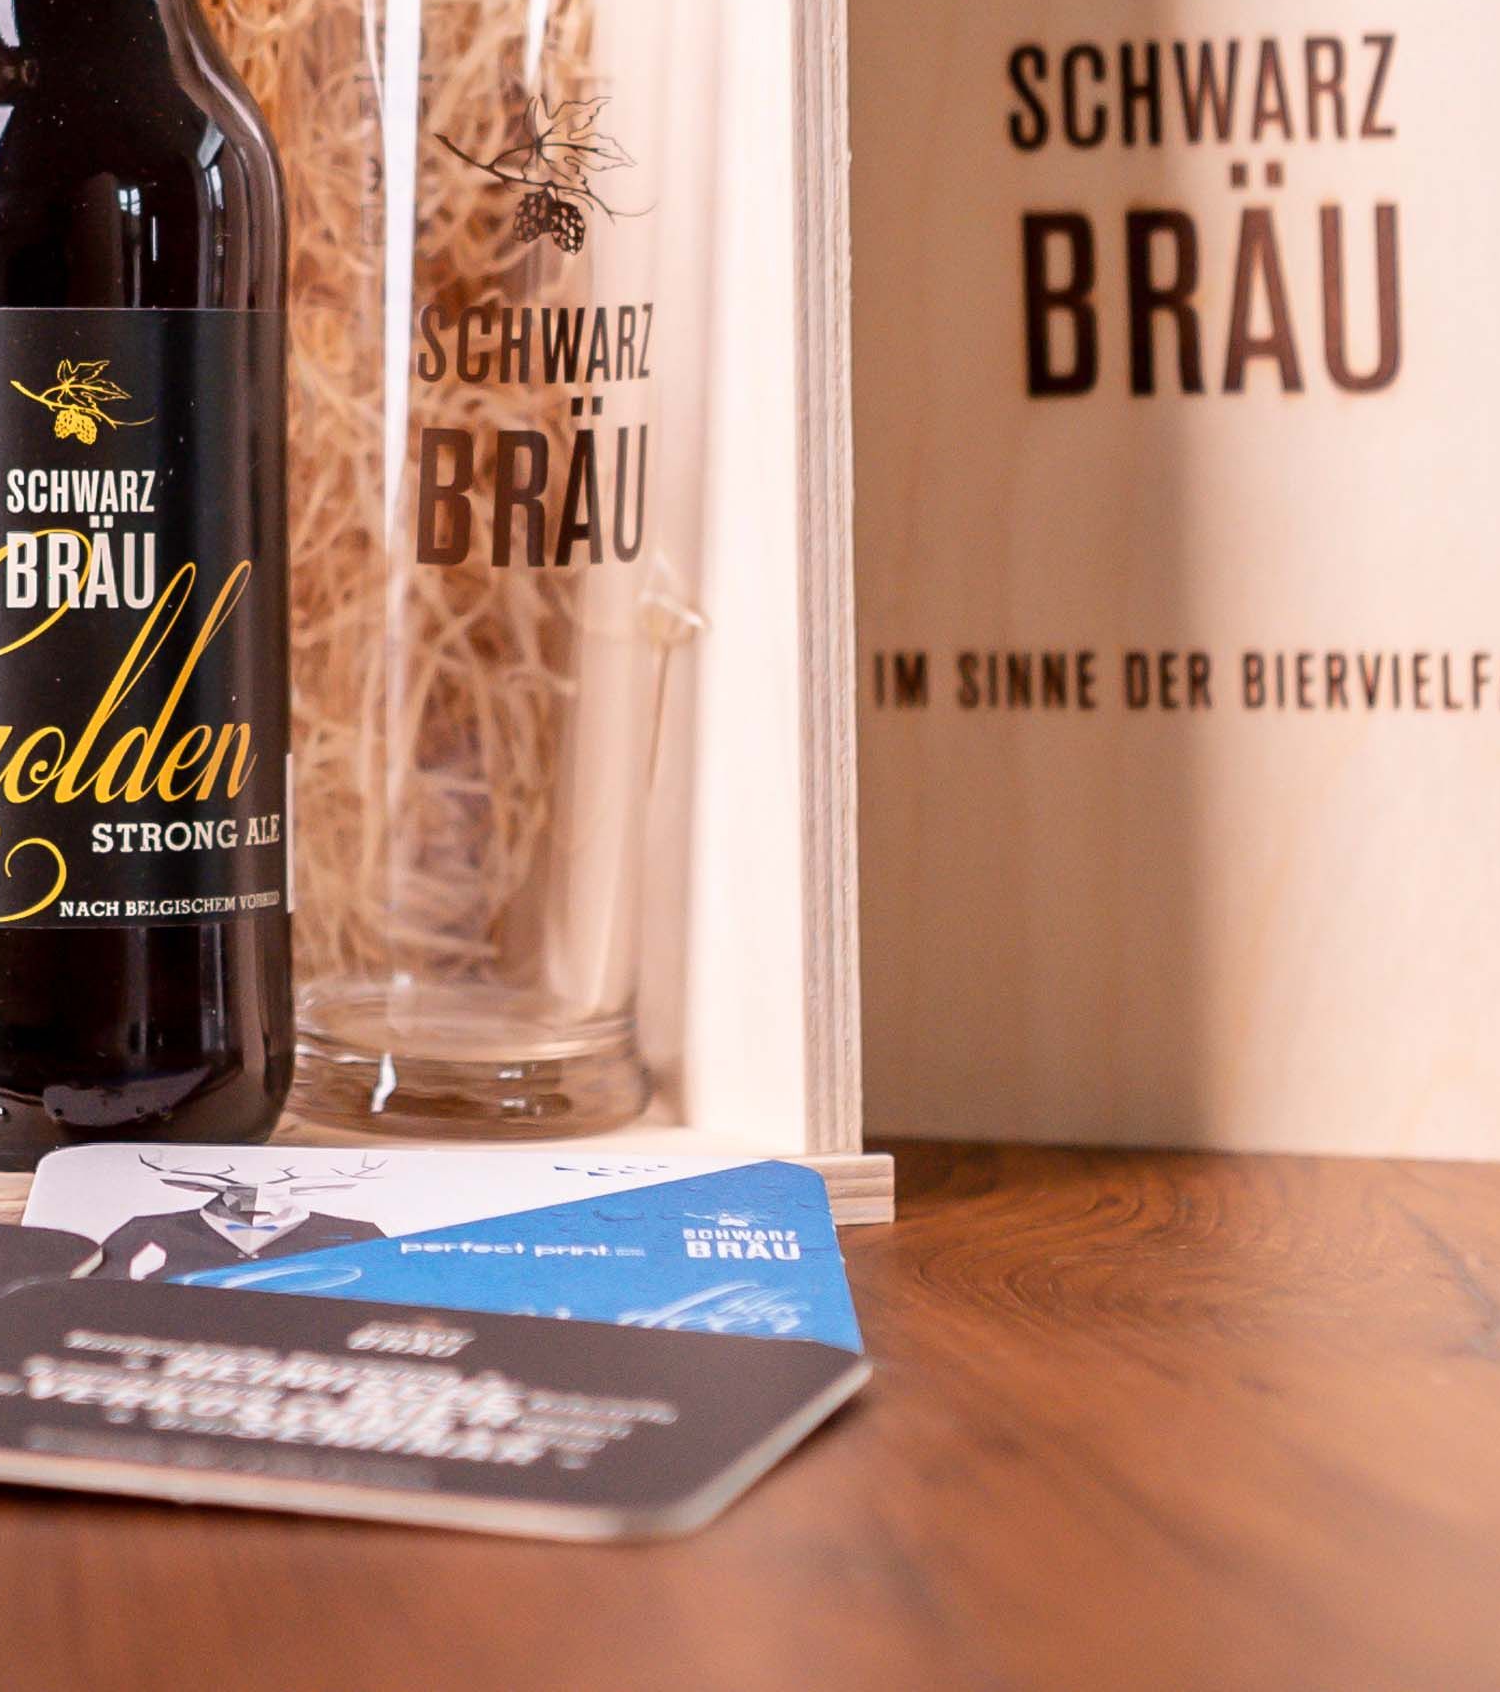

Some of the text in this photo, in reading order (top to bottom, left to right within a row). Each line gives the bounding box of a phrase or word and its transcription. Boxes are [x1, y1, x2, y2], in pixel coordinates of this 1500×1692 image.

[1007, 34, 1398, 152] SCHWARZ
[1021, 162, 1403, 400] BRÄU
[416, 302, 654, 384] SCHWARZ
[6, 468, 156, 514] SCHWARZ
[415, 396, 648, 568] BRÄU
[5, 515, 156, 609] BRÄU
[873, 651, 929, 710] IM
[956, 651, 1096, 710] SINNE
[1124, 651, 1213, 710] DER
[91, 814, 281, 853] STRONG ALE
[59, 900, 119, 918] NACH
[124, 895, 236, 917] BELGISCHEM
[400, 1240, 526, 1259] perfect
[683, 1228, 799, 1245] SCHWARZ
[687, 1239, 802, 1261] BRÄU
